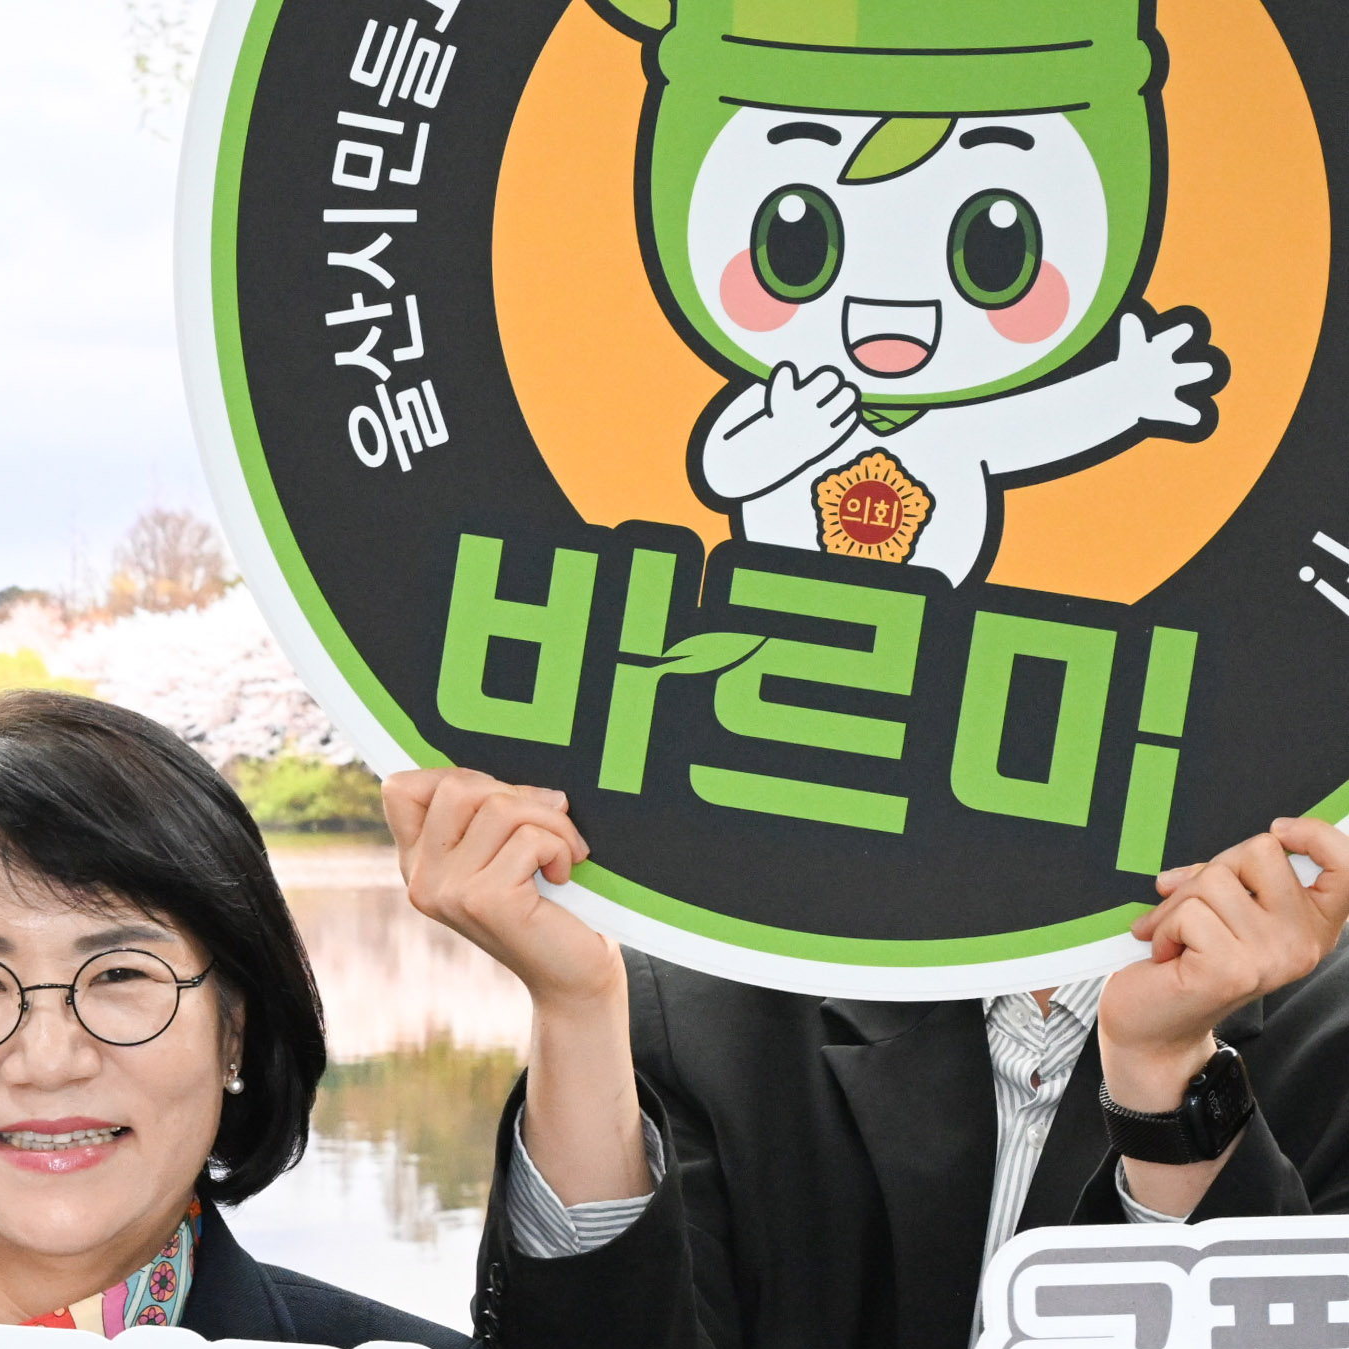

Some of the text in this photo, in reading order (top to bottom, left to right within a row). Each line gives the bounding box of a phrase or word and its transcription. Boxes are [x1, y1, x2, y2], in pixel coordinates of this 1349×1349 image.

[323, 0, 461, 473] 울산시민들
[841, 496, 900, 528] 의회
[435, 532, 1200, 878] 바르미
